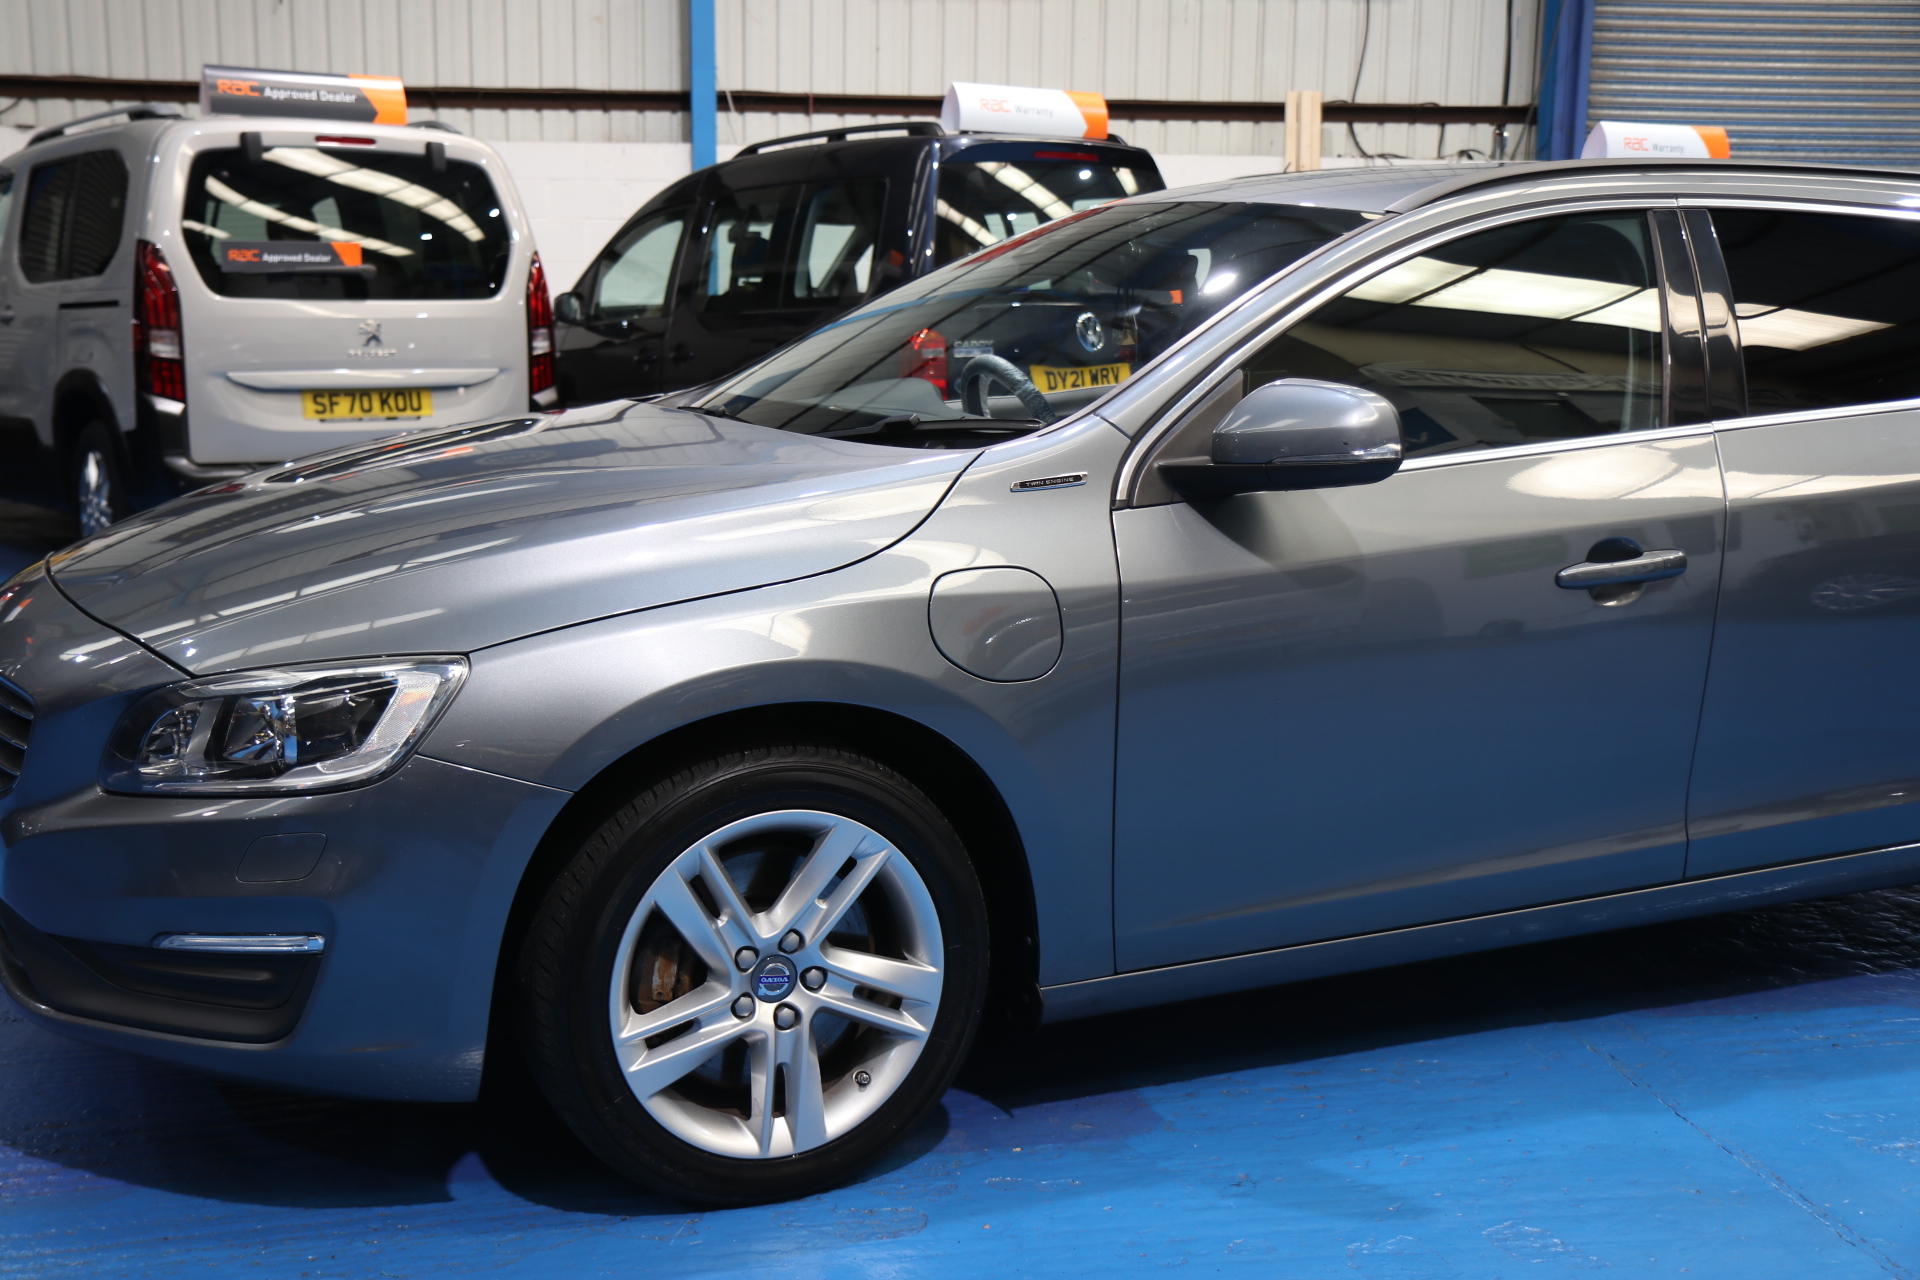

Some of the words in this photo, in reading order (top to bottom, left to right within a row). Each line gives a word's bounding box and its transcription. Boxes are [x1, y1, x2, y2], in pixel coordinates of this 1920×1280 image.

[263, 86, 317, 100] Approved
[319, 90, 357, 103] Dealer
[1014, 105, 1054, 118] Warranty
[1651, 143, 1684, 154] Warranty
[262, 252, 302, 263] Approved
[303, 253, 332, 263] Dealer
[1045, 370, 1086, 391] DY21
[1089, 366, 1120, 386] WRV
[378, 390, 423, 413] KOU
[1045, 476, 1074, 485] ENGINE
